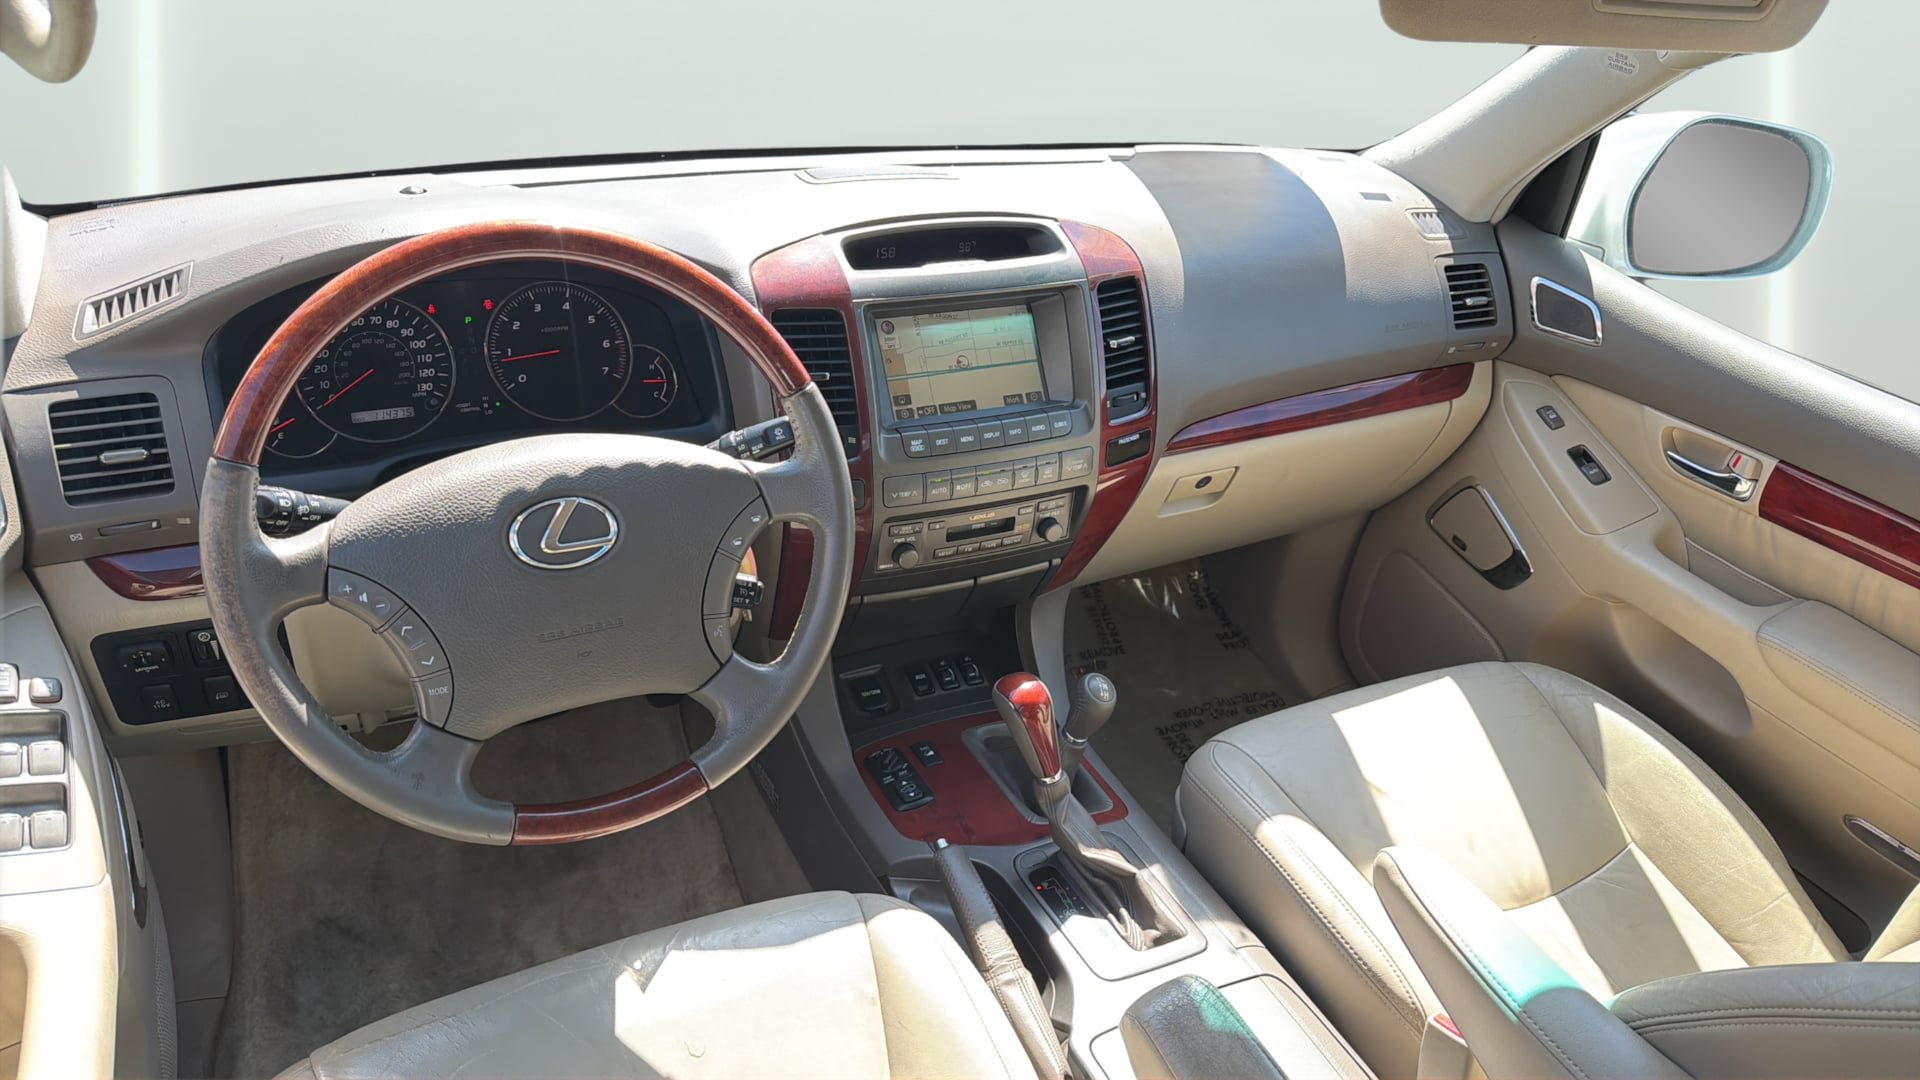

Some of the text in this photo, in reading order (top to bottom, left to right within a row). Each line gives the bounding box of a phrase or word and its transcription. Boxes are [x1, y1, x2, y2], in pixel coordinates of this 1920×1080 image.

[534, 303, 541, 312] 3
[562, 302, 570, 310] 4
[369, 316, 382, 325] 70
[386, 319, 399, 328] 80
[464, 316, 472, 324] P
[588, 315, 595, 324] 5
[512, 321, 521, 330] 2
[400, 328, 414, 337] 90
[409, 340, 426, 349] 100
[602, 340, 610, 348] 6
[507, 348, 512, 356] 1
[417, 354, 432, 363] 110
[314, 365, 327, 373] 20
[419, 368, 435, 377] 120
[602, 367, 609, 376] 7
[518, 374, 527, 383] 0
[320, 381, 329, 389] 10
[417, 383, 433, 392] 130
[924, 406, 936, 415] OFF
[943, 404, 957, 413] Map
[935, 438, 948, 446] DEST
[931, 487, 947, 495] AUTO
[428, 686, 449, 696] MODE
